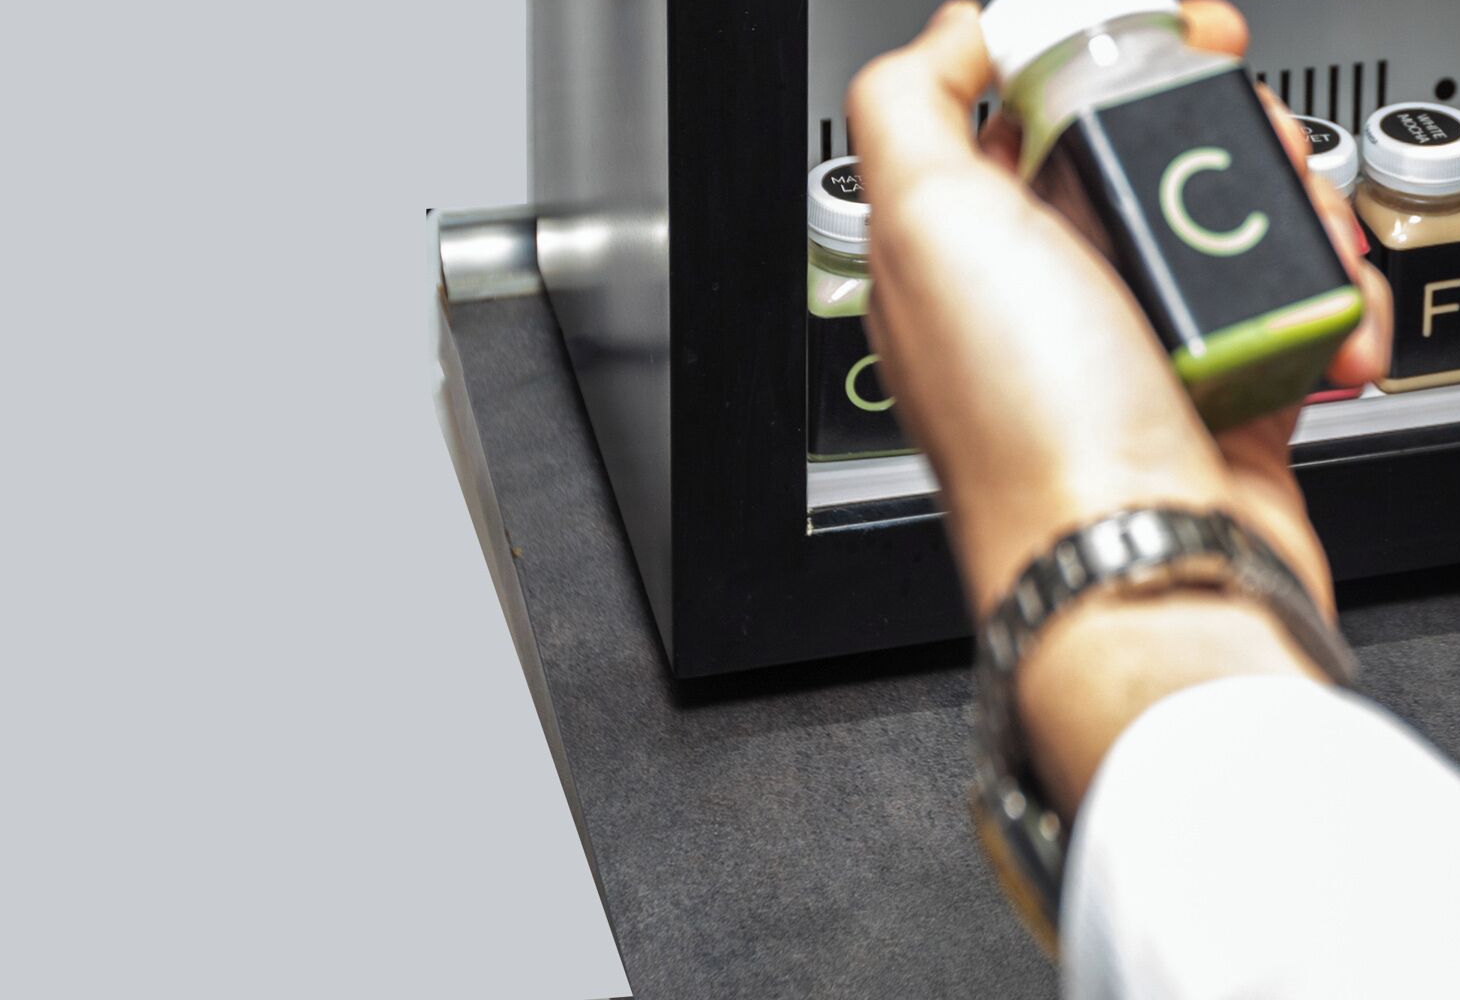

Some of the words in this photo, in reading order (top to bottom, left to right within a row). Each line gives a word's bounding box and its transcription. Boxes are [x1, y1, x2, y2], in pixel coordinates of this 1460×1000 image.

[1397, 113, 1431, 143] MOCHA
[1416, 113, 1448, 139] WHITE
[1159, 147, 1270, 256] C
[845, 354, 895, 412] C
